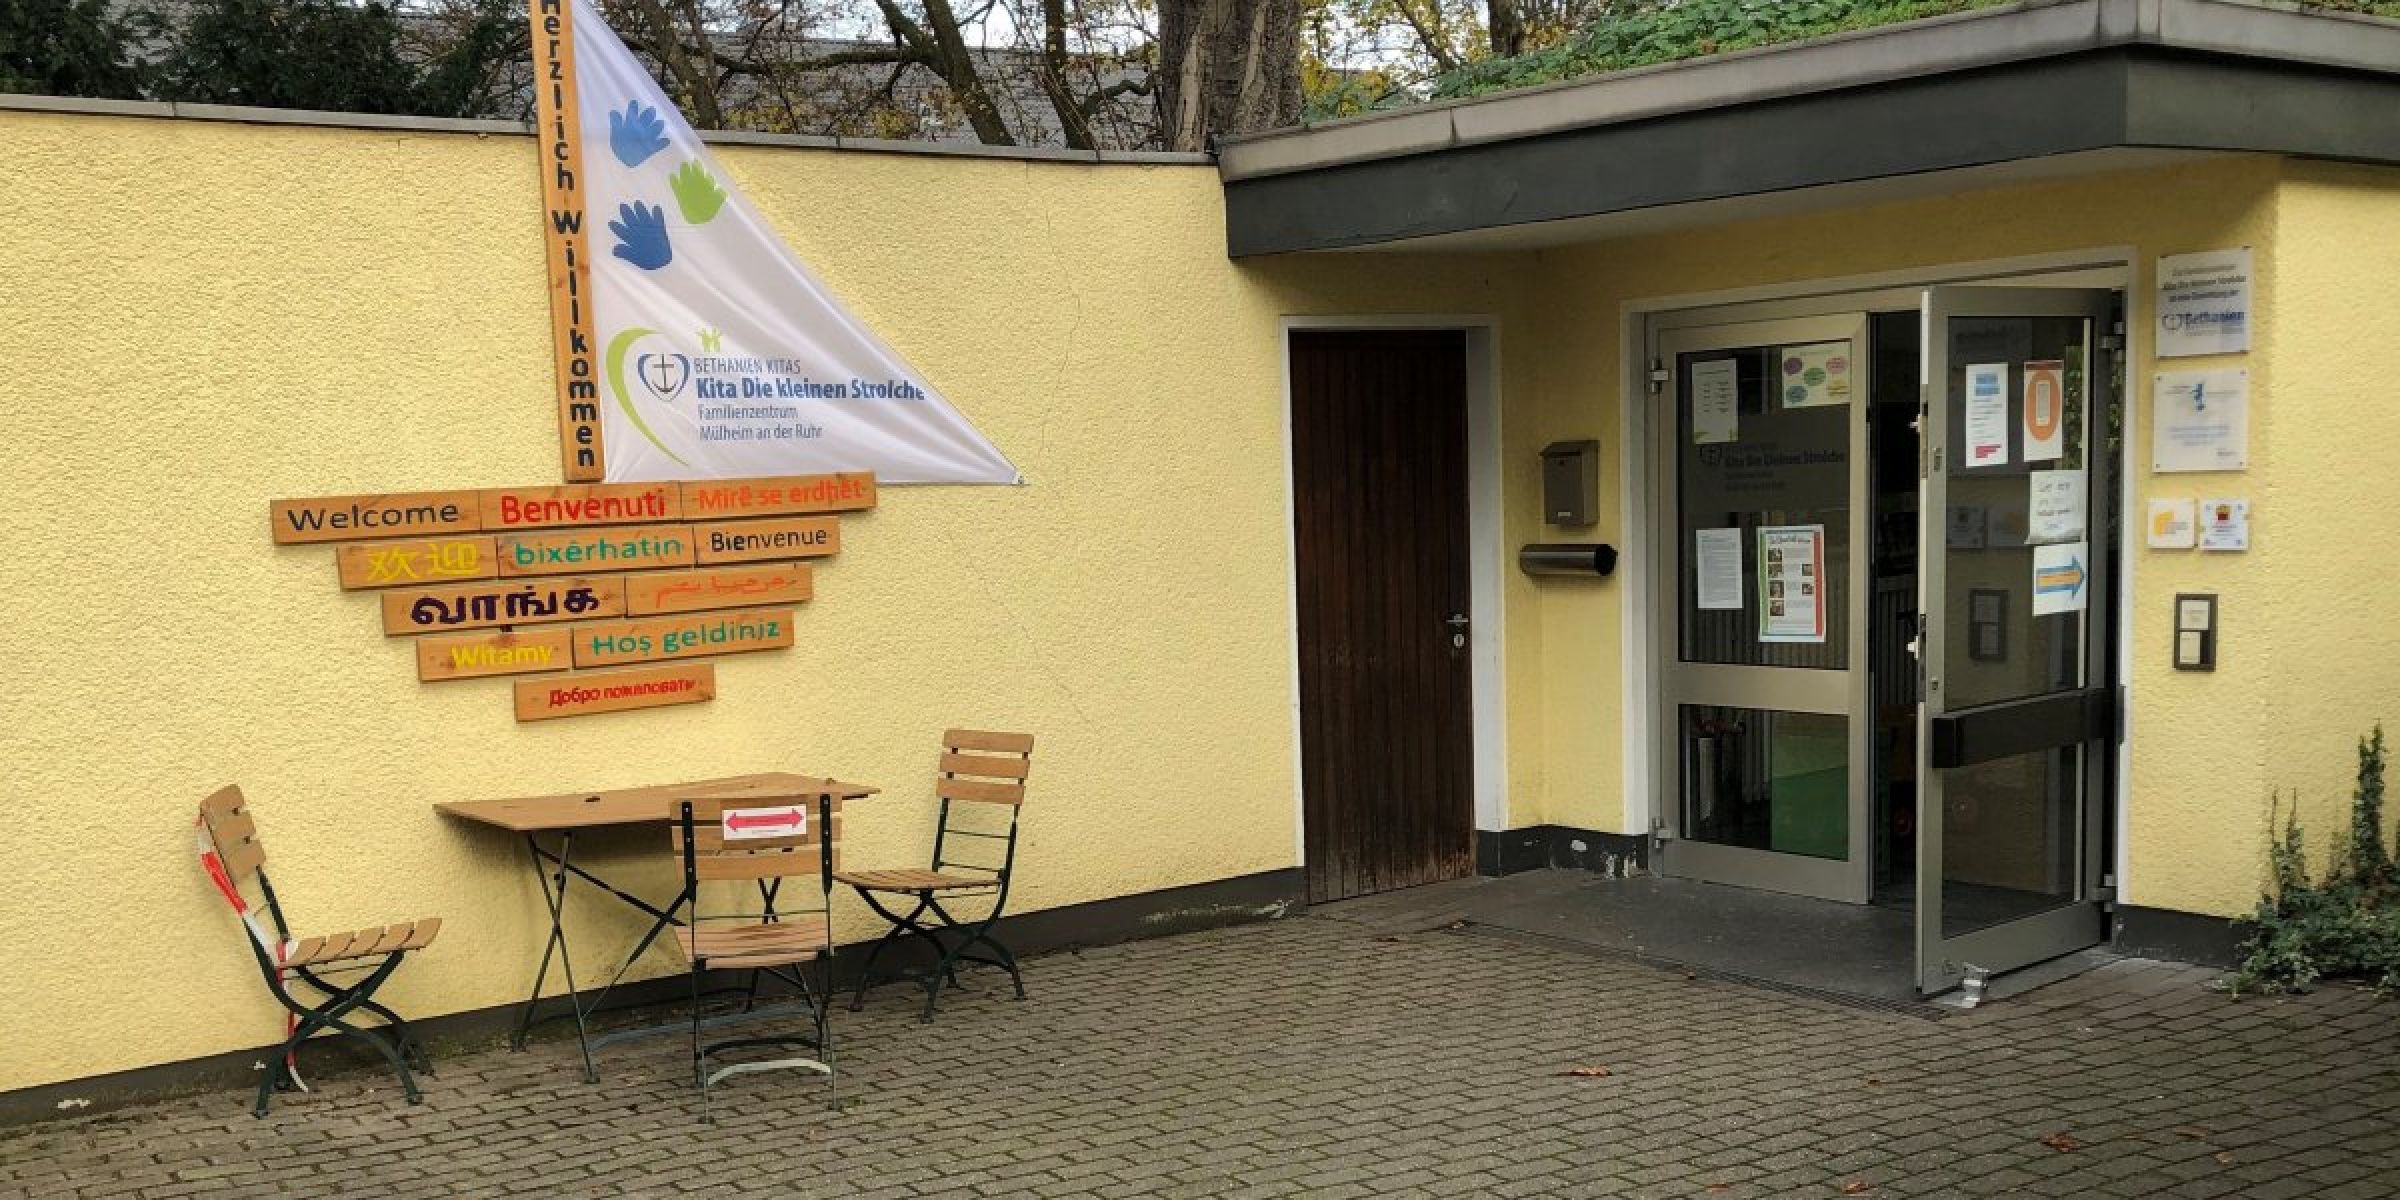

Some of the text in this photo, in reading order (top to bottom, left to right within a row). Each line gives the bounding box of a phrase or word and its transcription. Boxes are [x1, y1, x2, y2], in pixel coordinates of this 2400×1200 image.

[540, 0, 597, 467] Herzlich Willkommen
[694, 357, 801, 374] BETHANIEN KITAS
[696, 377, 926, 400] Kita Die kleinen Strolche
[698, 404, 799, 420] Familienzentrum
[699, 423, 823, 441] Mülheim an der Ruhr
[501, 488, 665, 525] Benvenuti
[759, 489, 782, 506] se
[287, 503, 459, 531] Welcome
[710, 528, 827, 554] Bienvenue
[368, 541, 481, 582] 欢迎
[411, 586, 600, 625] வாங்க
[591, 619, 781, 656] Hoş geldiniz
[451, 644, 554, 669] Witamy
[549, 679, 696, 708] Добро пожаловать
